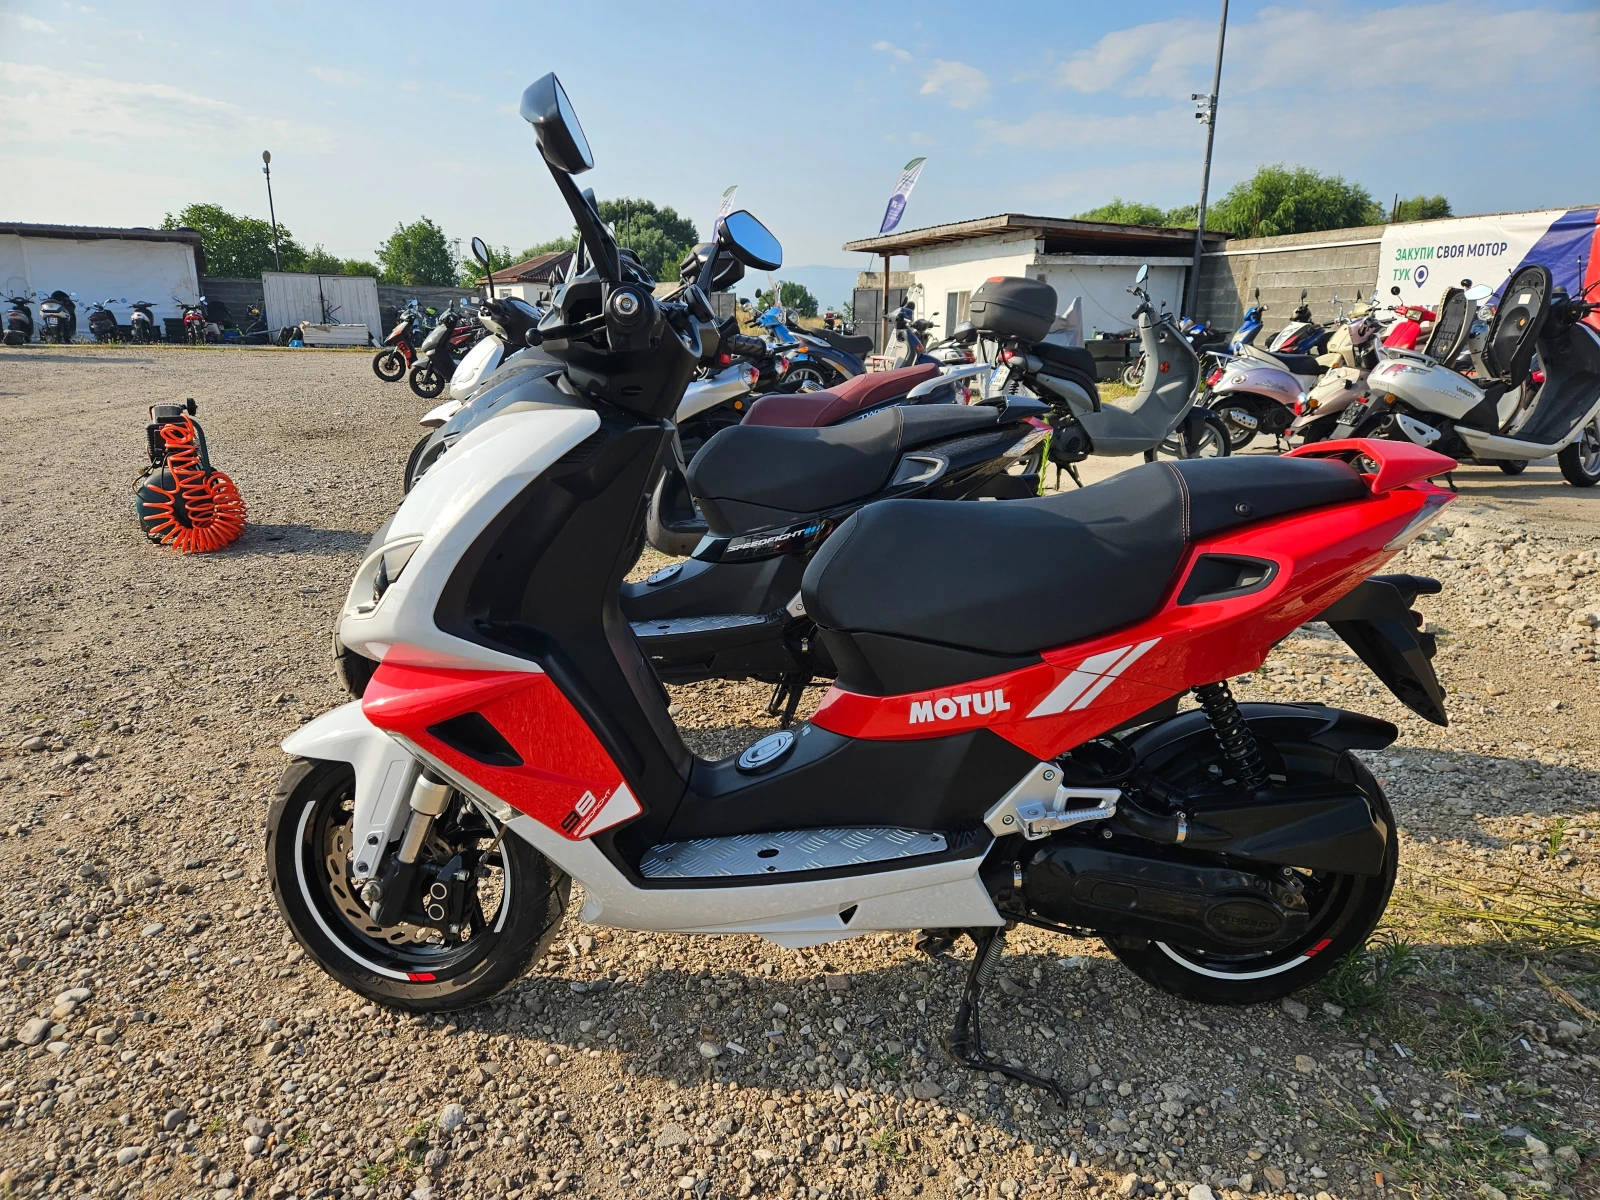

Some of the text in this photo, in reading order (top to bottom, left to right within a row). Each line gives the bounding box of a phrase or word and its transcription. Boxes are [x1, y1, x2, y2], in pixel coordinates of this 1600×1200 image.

[1395, 242, 1507, 261] ЗАКУПИ СВОЯ МОТОР
[1393, 268, 1411, 281] ТУК
[726, 528, 805, 553] SPEEDFIGHT
[909, 689, 1010, 724] MOTUL
[1213, 912, 1276, 928] PEUGEOT
